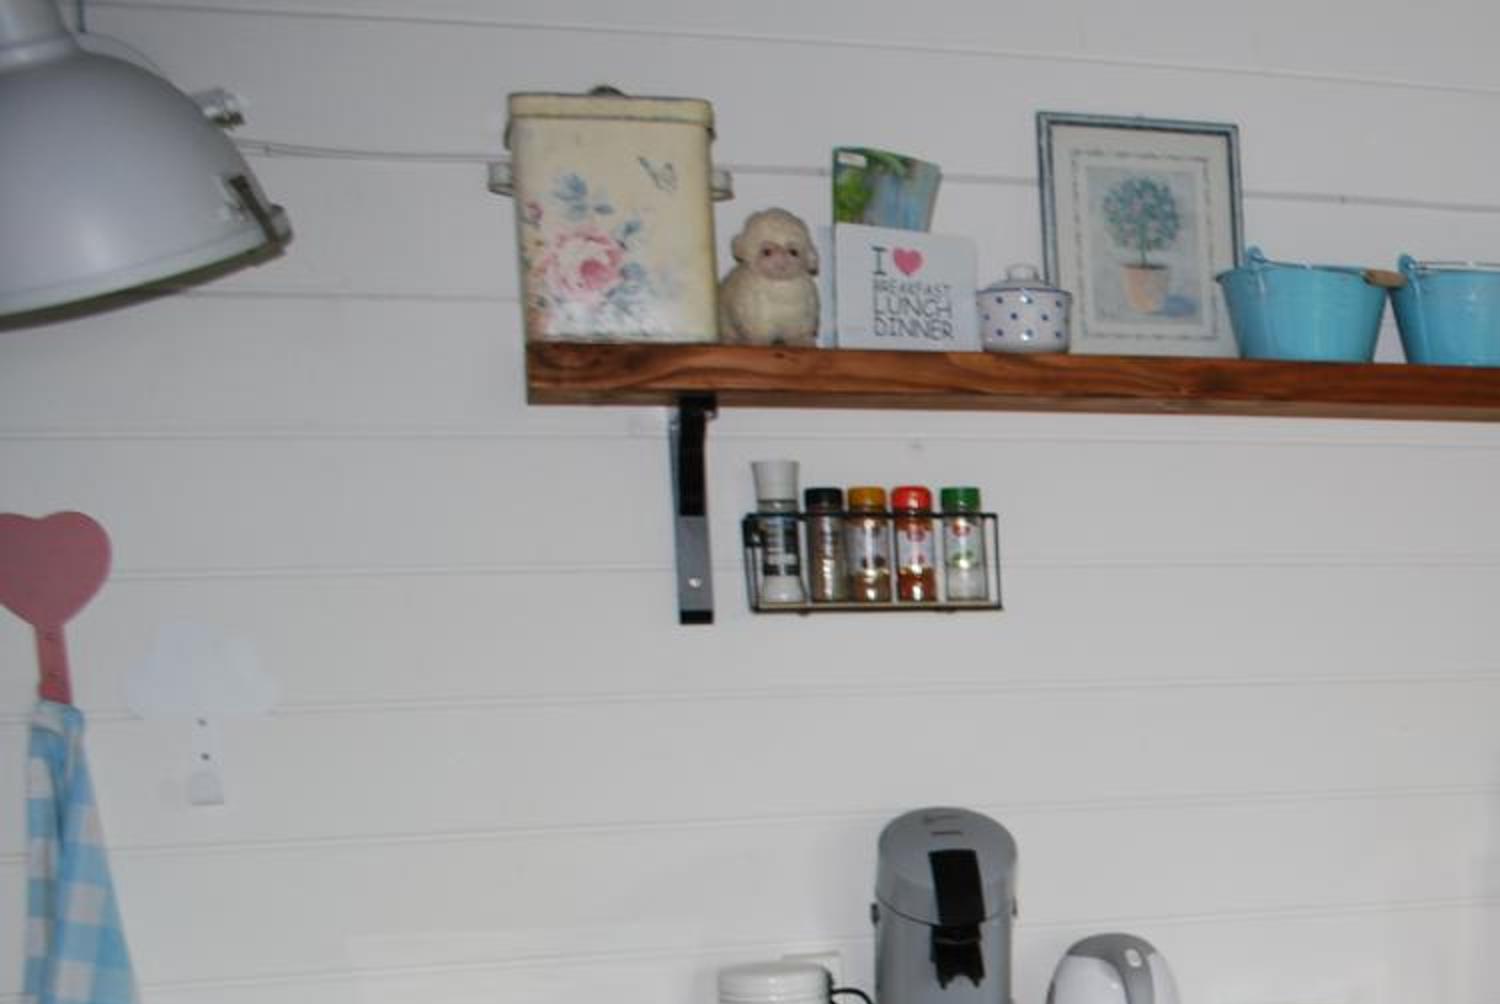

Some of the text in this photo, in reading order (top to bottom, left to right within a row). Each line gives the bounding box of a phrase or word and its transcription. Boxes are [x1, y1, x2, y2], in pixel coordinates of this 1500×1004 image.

[871, 245, 888, 276] I
[873, 296, 953, 319] LUNCH
[874, 317, 954, 340] DINNER
